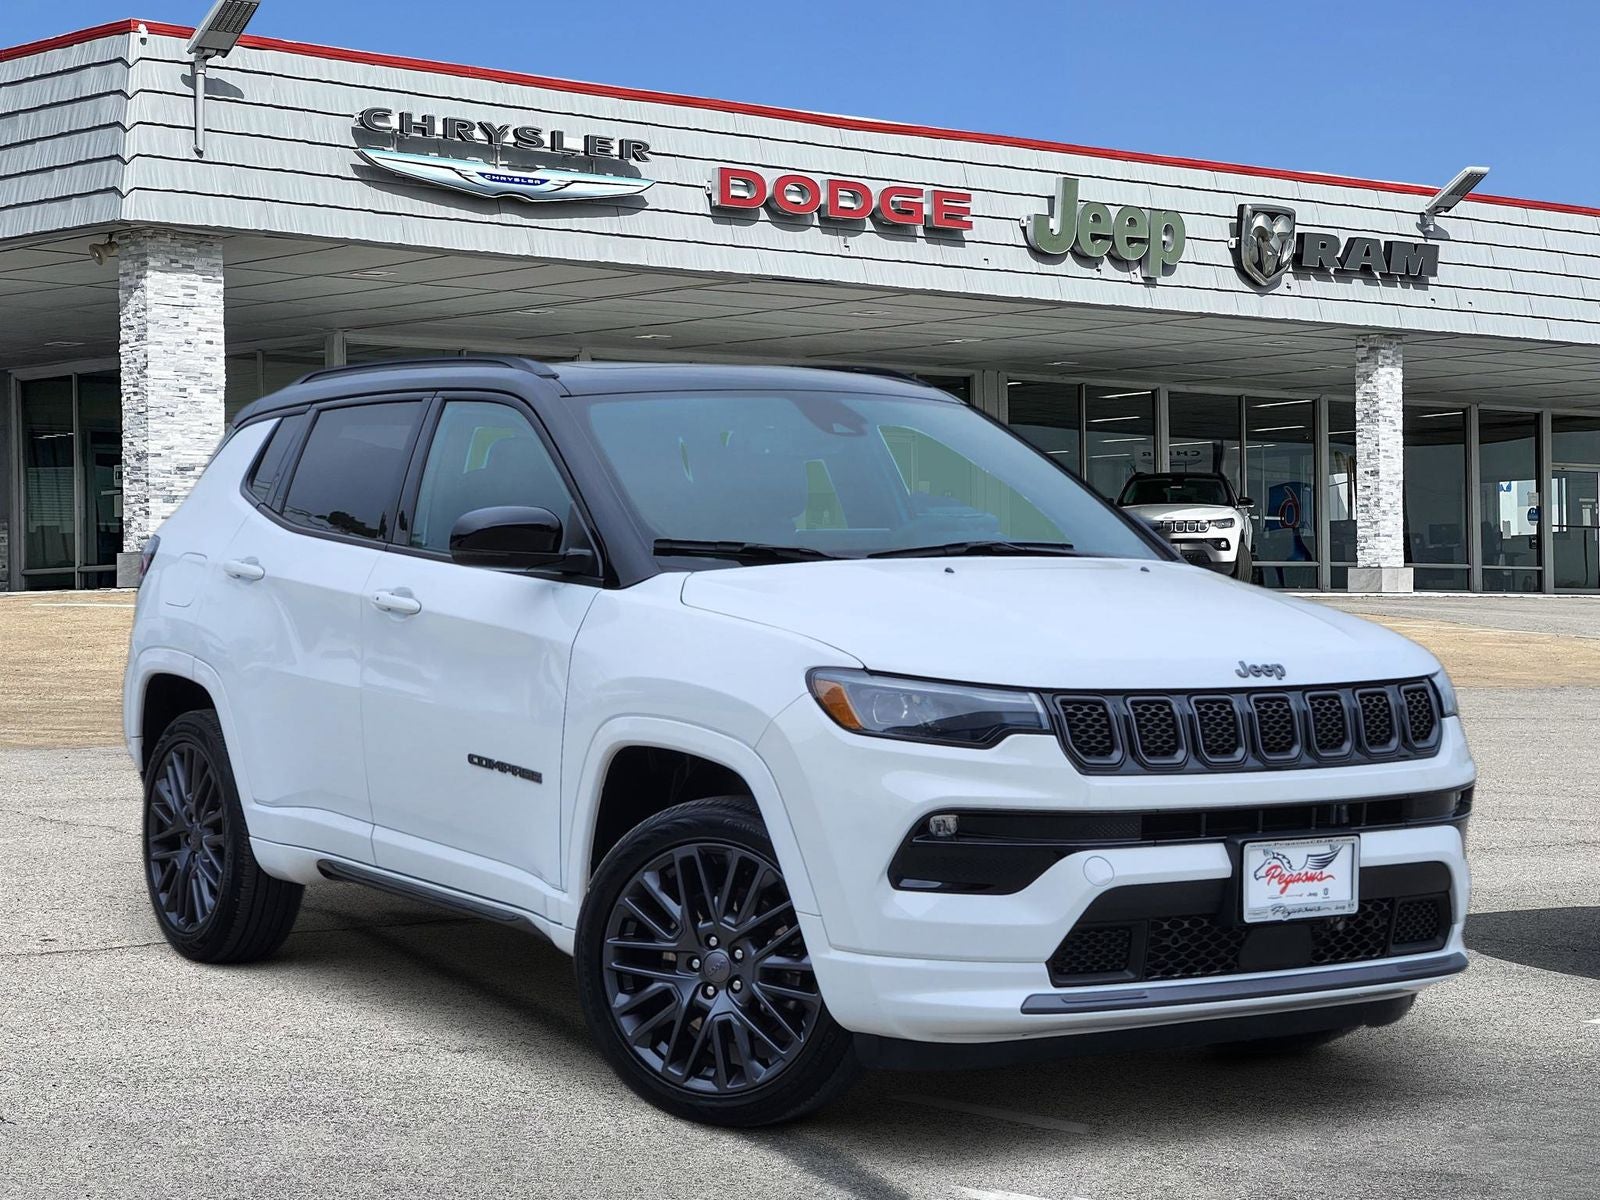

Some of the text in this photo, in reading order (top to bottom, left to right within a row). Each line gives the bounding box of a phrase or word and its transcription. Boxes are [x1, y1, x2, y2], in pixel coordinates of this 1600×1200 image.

[357, 106, 650, 162] CHRYSLER
[484, 174, 541, 185] CHRYSLER
[712, 167, 973, 231] DODGE
[1026, 177, 1186, 279] Jeep
[1297, 232, 1440, 277] RAM
[1235, 660, 1286, 680] Jeep
[1265, 864, 1336, 895] Pegasus
